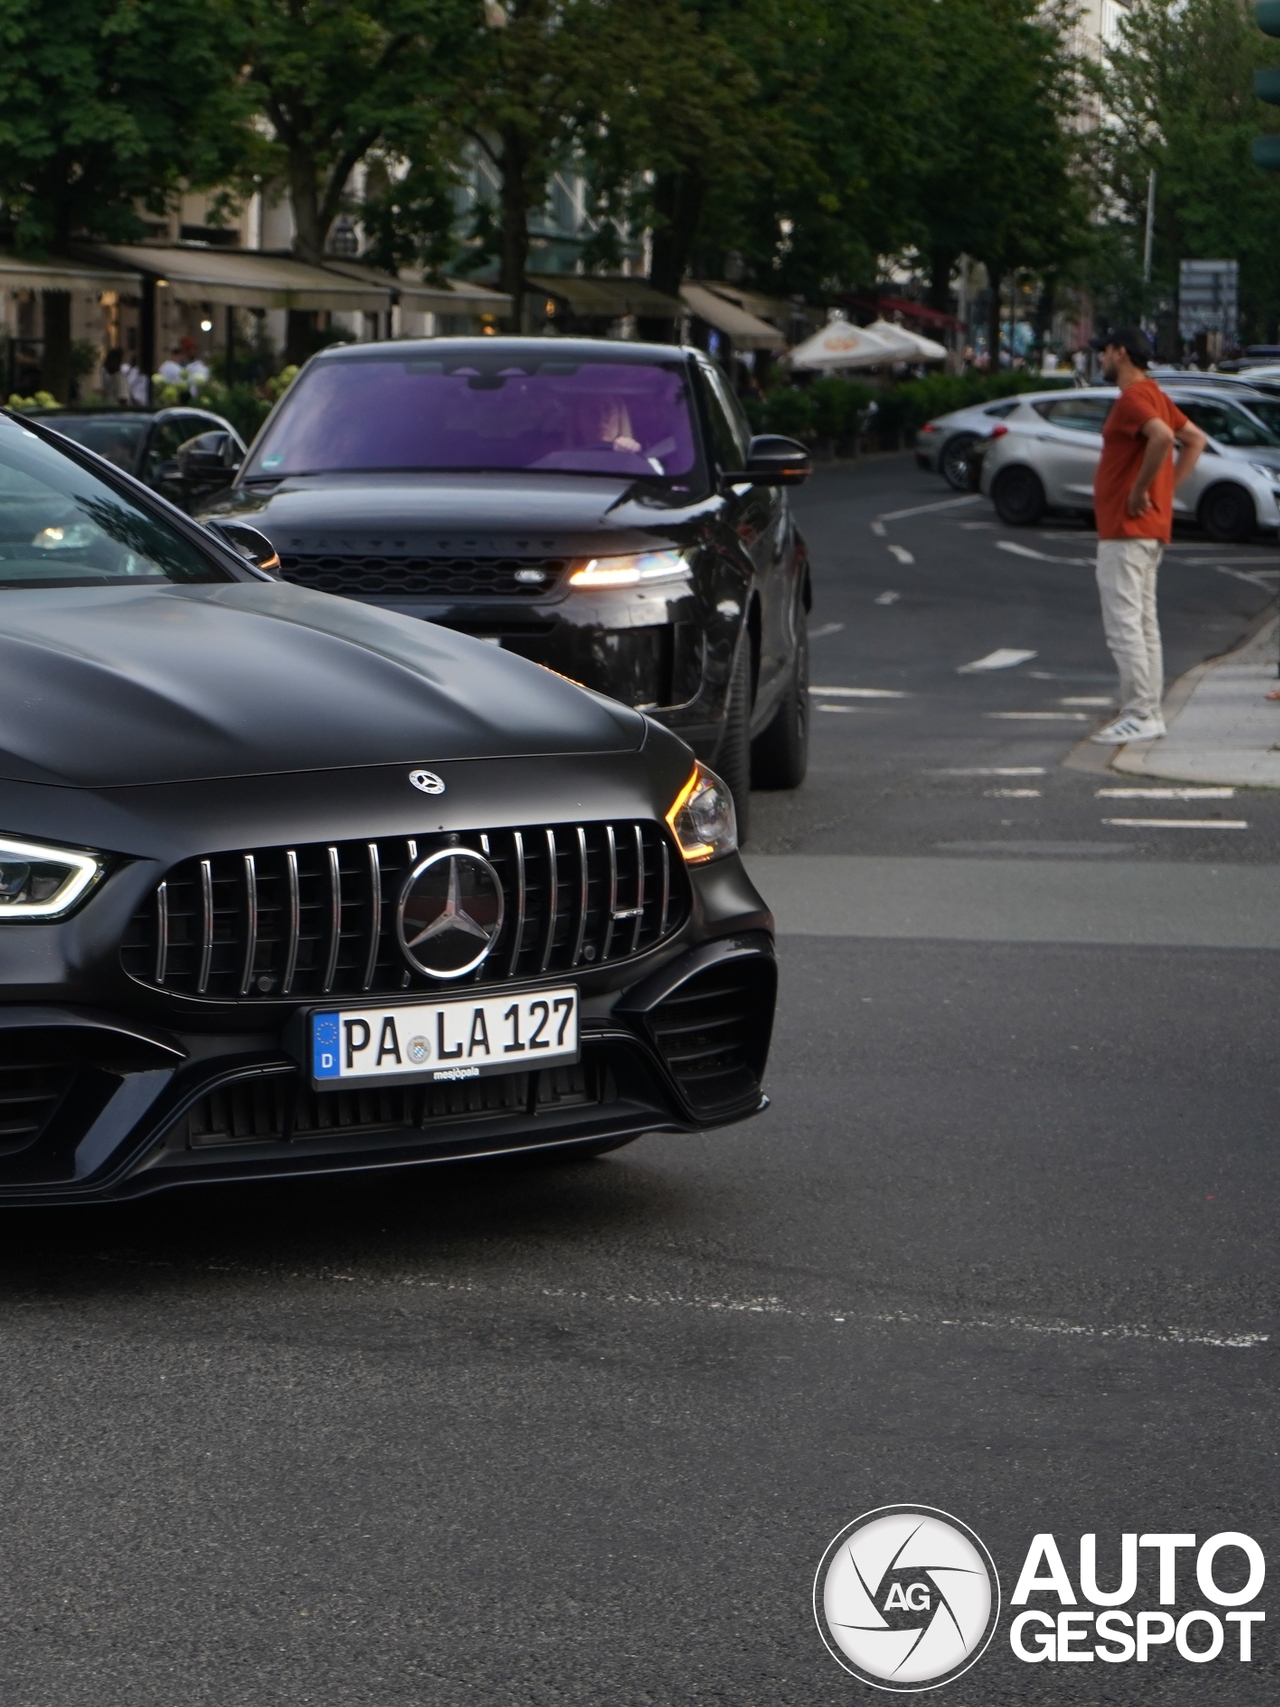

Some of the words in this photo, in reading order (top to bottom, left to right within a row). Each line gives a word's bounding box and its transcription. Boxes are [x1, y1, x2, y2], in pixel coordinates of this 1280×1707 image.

[343, 1016, 402, 1069] PA
[437, 1008, 491, 1060] LA
[504, 996, 574, 1053] 127
[322, 1053, 333, 1068] D
